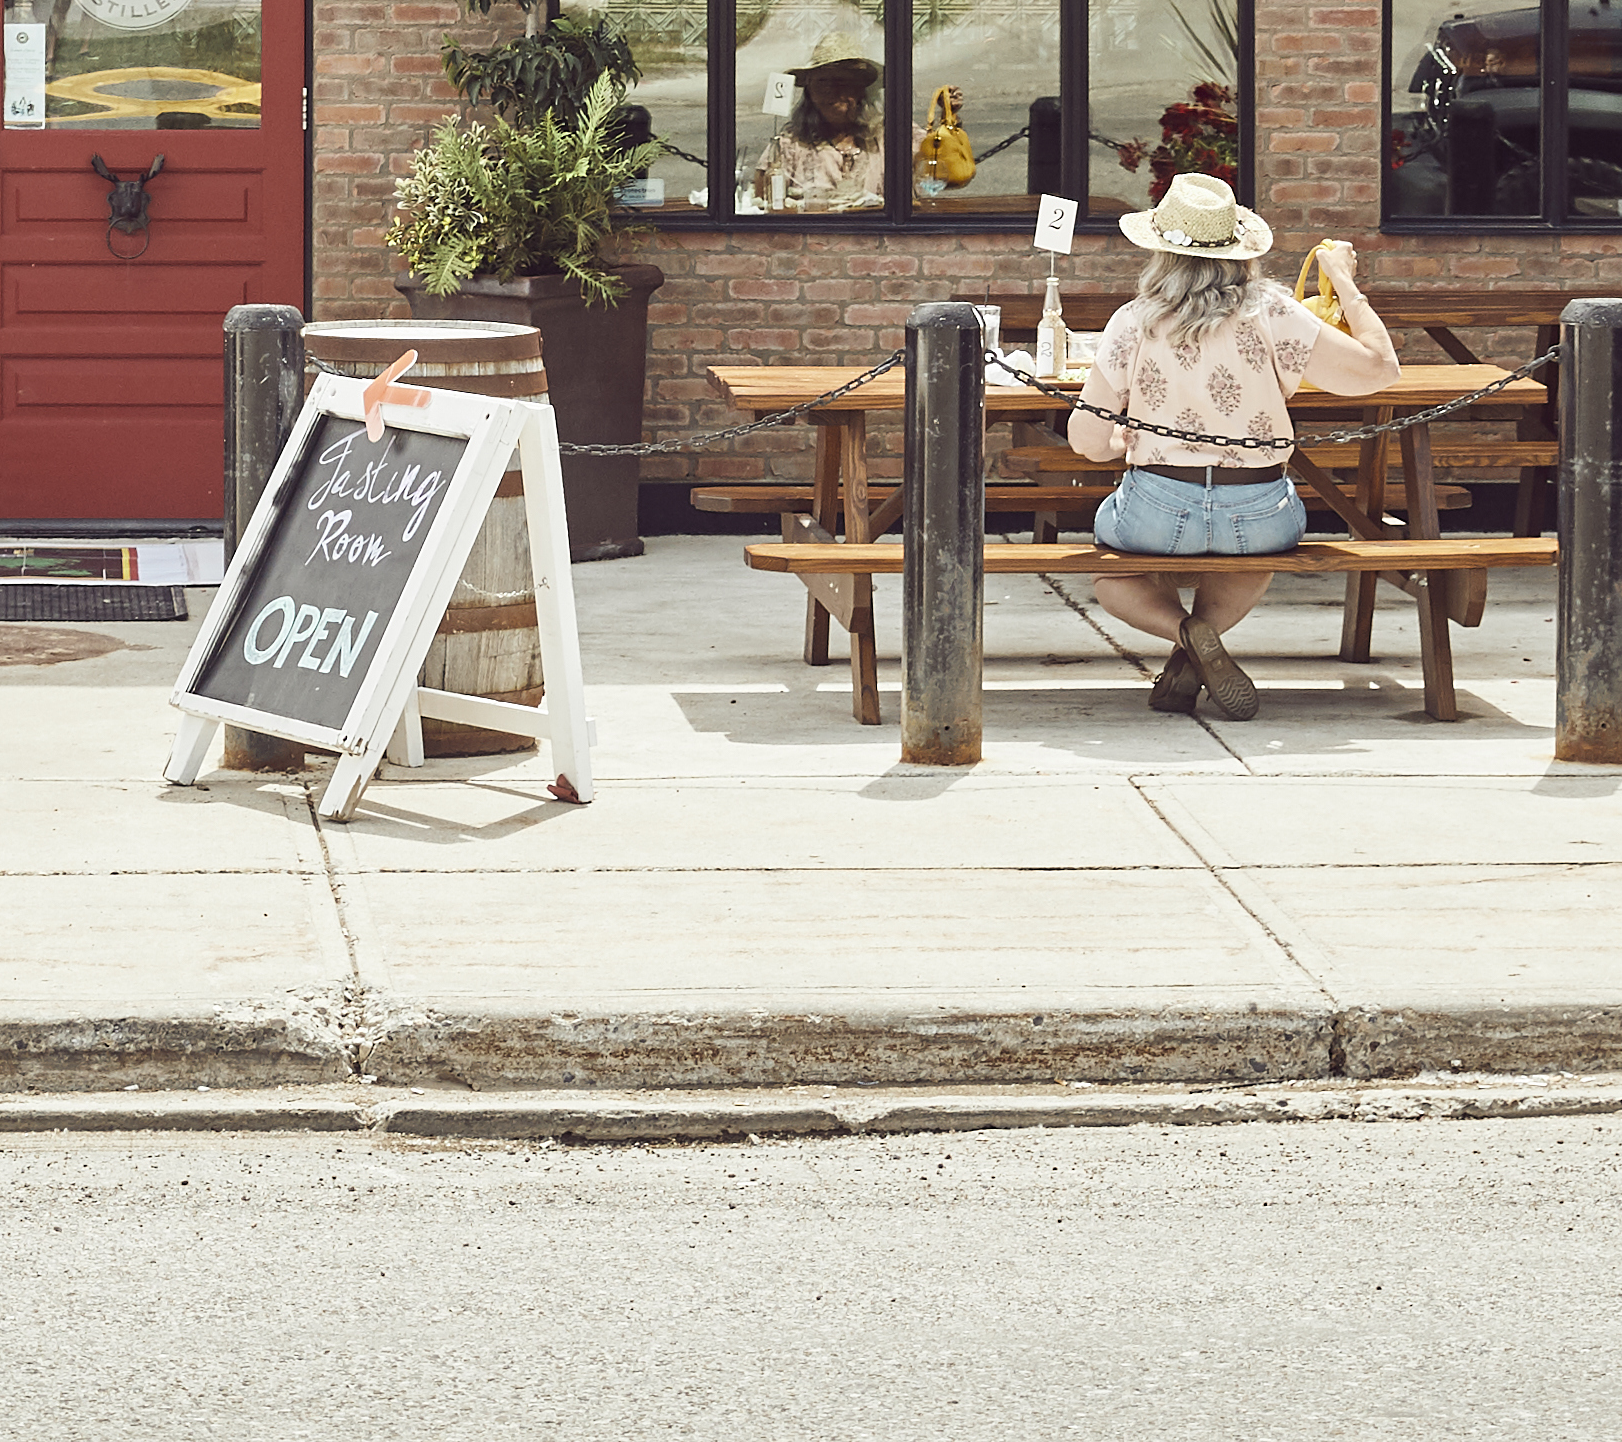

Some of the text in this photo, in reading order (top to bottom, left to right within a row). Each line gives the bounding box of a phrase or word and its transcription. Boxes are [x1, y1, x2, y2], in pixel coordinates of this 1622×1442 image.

[1048, 208, 1064, 230] 2
[307, 430, 445, 542] Tasting
[305, 508, 392, 567] Room
[243, 595, 378, 678] OPEN
